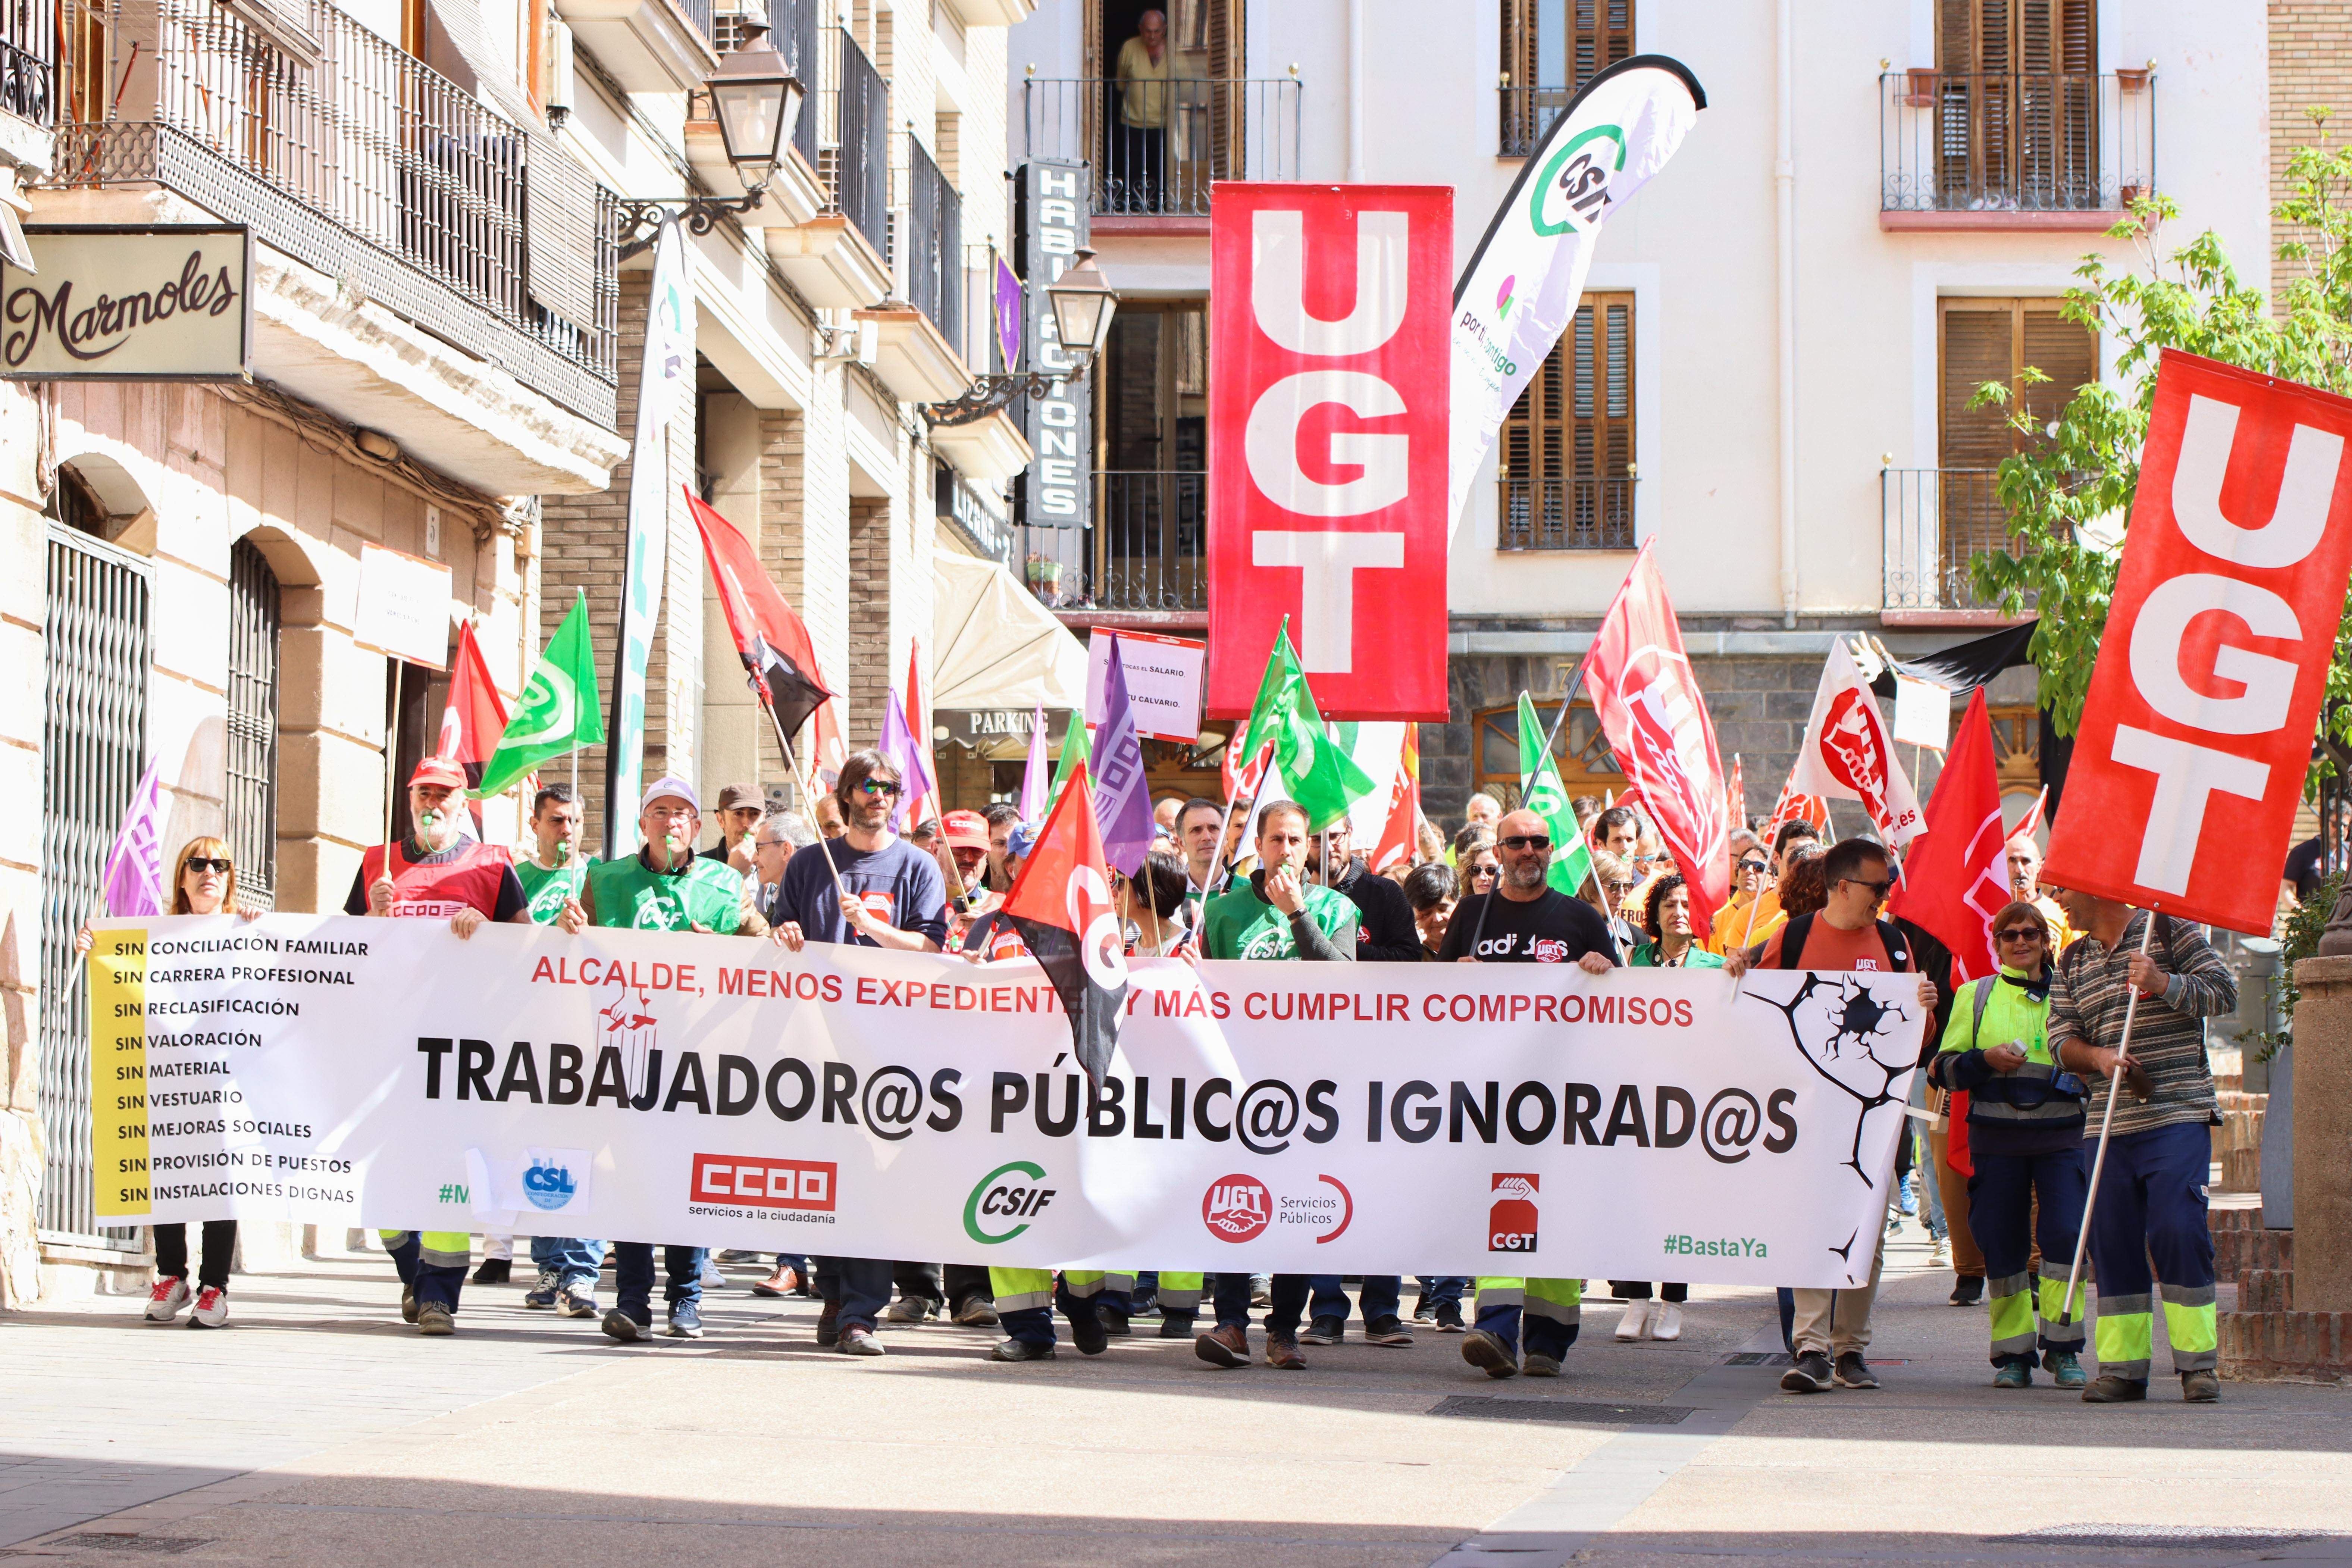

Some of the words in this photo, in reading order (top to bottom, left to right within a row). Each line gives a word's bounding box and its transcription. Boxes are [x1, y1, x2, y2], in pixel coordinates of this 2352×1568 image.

[6, 250, 239, 367] Marmoles
[1040, 169, 1077, 514] HABIACIONES
[1460, 311, 1481, 334] por
[1484, 337, 1517, 376] contigo
[1244, 209, 1409, 674] UGT
[429, 517, 436, 543] 5
[2111, 393, 2345, 897] UGT
[1557, 662, 1575, 691] 7
[1139, 696, 1180, 708] CALVARIO.
[393, 904, 440, 917] CCOO
[115, 942, 145, 956] SIN
[151, 935, 279, 955] CONCILIACIÓN
[286, 939, 369, 957] FAMILIAR
[1477, 933, 1568, 957] adids
[1537, 944, 1559, 955] UGT
[1856, 958, 1877, 970] UGT
[113, 971, 144, 985] SIN
[150, 967, 225, 984] CARRERA
[232, 967, 355, 985] PROFESIONAL
[532, 956, 705, 998] ALCALDE,
[718, 967, 842, 1002] MENOS
[856, 977, 1084, 1015] EXPEDIENTE
[1154, 983, 1230, 1019] MÁS
[1244, 992, 1410, 1021] CUMPLIR
[1423, 994, 1693, 1027] COMPROMISOS
[115, 1003, 142, 1017] SIN
[148, 998, 300, 1016] RECLASIFICACIÓN
[116, 1036, 143, 1051] SIN
[148, 1029, 262, 1049] VALORACIÓN
[117, 1066, 144, 1080] SIN
[150, 1061, 231, 1078] MATERIAL
[117, 1095, 145, 1110] SIN
[150, 1090, 242, 1107] VESTUARIO
[418, 1037, 962, 1140] TRABAJADOR@S
[991, 1053, 1339, 1155] PÚBLIC@S
[1368, 1080, 1797, 1164] IGNORAD@S
[118, 1125, 146, 1139] SIN
[152, 1120, 225, 1137] MEJORAS
[233, 1120, 312, 1138] SOCIALES
[119, 1158, 147, 1173] SIN
[153, 1149, 244, 1171] PROVISIÓN
[251, 1153, 272, 1168] DE
[279, 1155, 351, 1174] PUESTOS
[526, 1166, 574, 1193] CSL
[701, 1163, 828, 1201] CCOO
[120, 1187, 148, 1202] SIN
[154, 1182, 282, 1200] INSTALACIONES
[289, 1185, 355, 1204] DIGNAS
[529, 1195, 554, 1209] SEGURIDAD
[554, 1199, 568, 1209] LOCAL
[982, 1186, 1056, 1217] CSIF
[1210, 1185, 1264, 1213] UGT
[1280, 1196, 1336, 1208] Servicios
[689, 1206, 743, 1218] servicios
[758, 1209, 767, 1220] la
[771, 1210, 836, 1224] ciudadanía
[1280, 1212, 1332, 1224] Públicos
[1492, 1232, 1535, 1250] CGT
[1664, 1234, 1767, 1258] #BastaYa
